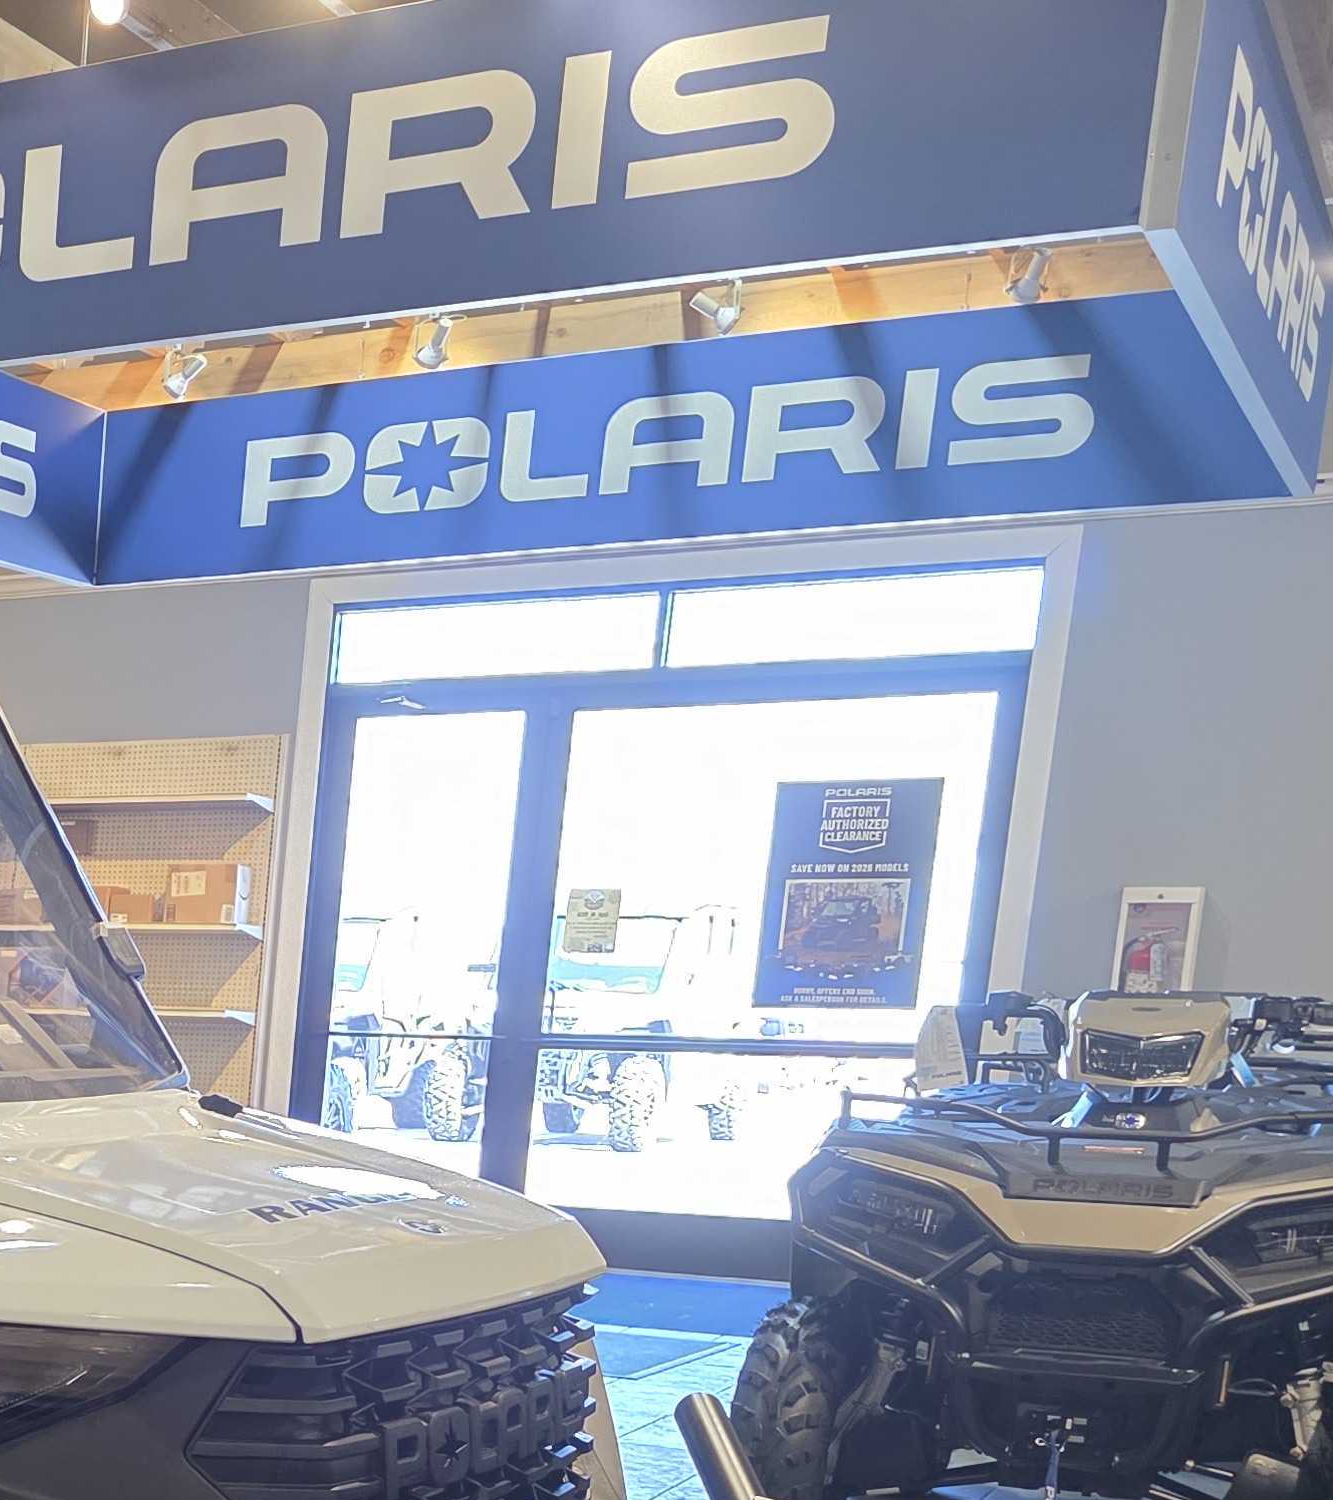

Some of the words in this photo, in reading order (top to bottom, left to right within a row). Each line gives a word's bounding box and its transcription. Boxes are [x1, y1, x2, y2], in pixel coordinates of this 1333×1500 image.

[1216, 44, 1326, 402] POLARIS
[239, 353, 1096, 529] POLARIS
[825, 787, 893, 797] POLARIS
[831, 805, 881, 818] FACTORY
[820, 818, 889, 831] AUTHORIZED
[824, 831, 882, 842] CLEARANCE
[791, 864, 813, 873] SAVE
[815, 864, 835, 873] NOW
[837, 864, 850, 873] ON
[874, 863, 910, 873] MODELS
[1033, 1177, 1174, 1199] POLARIS
